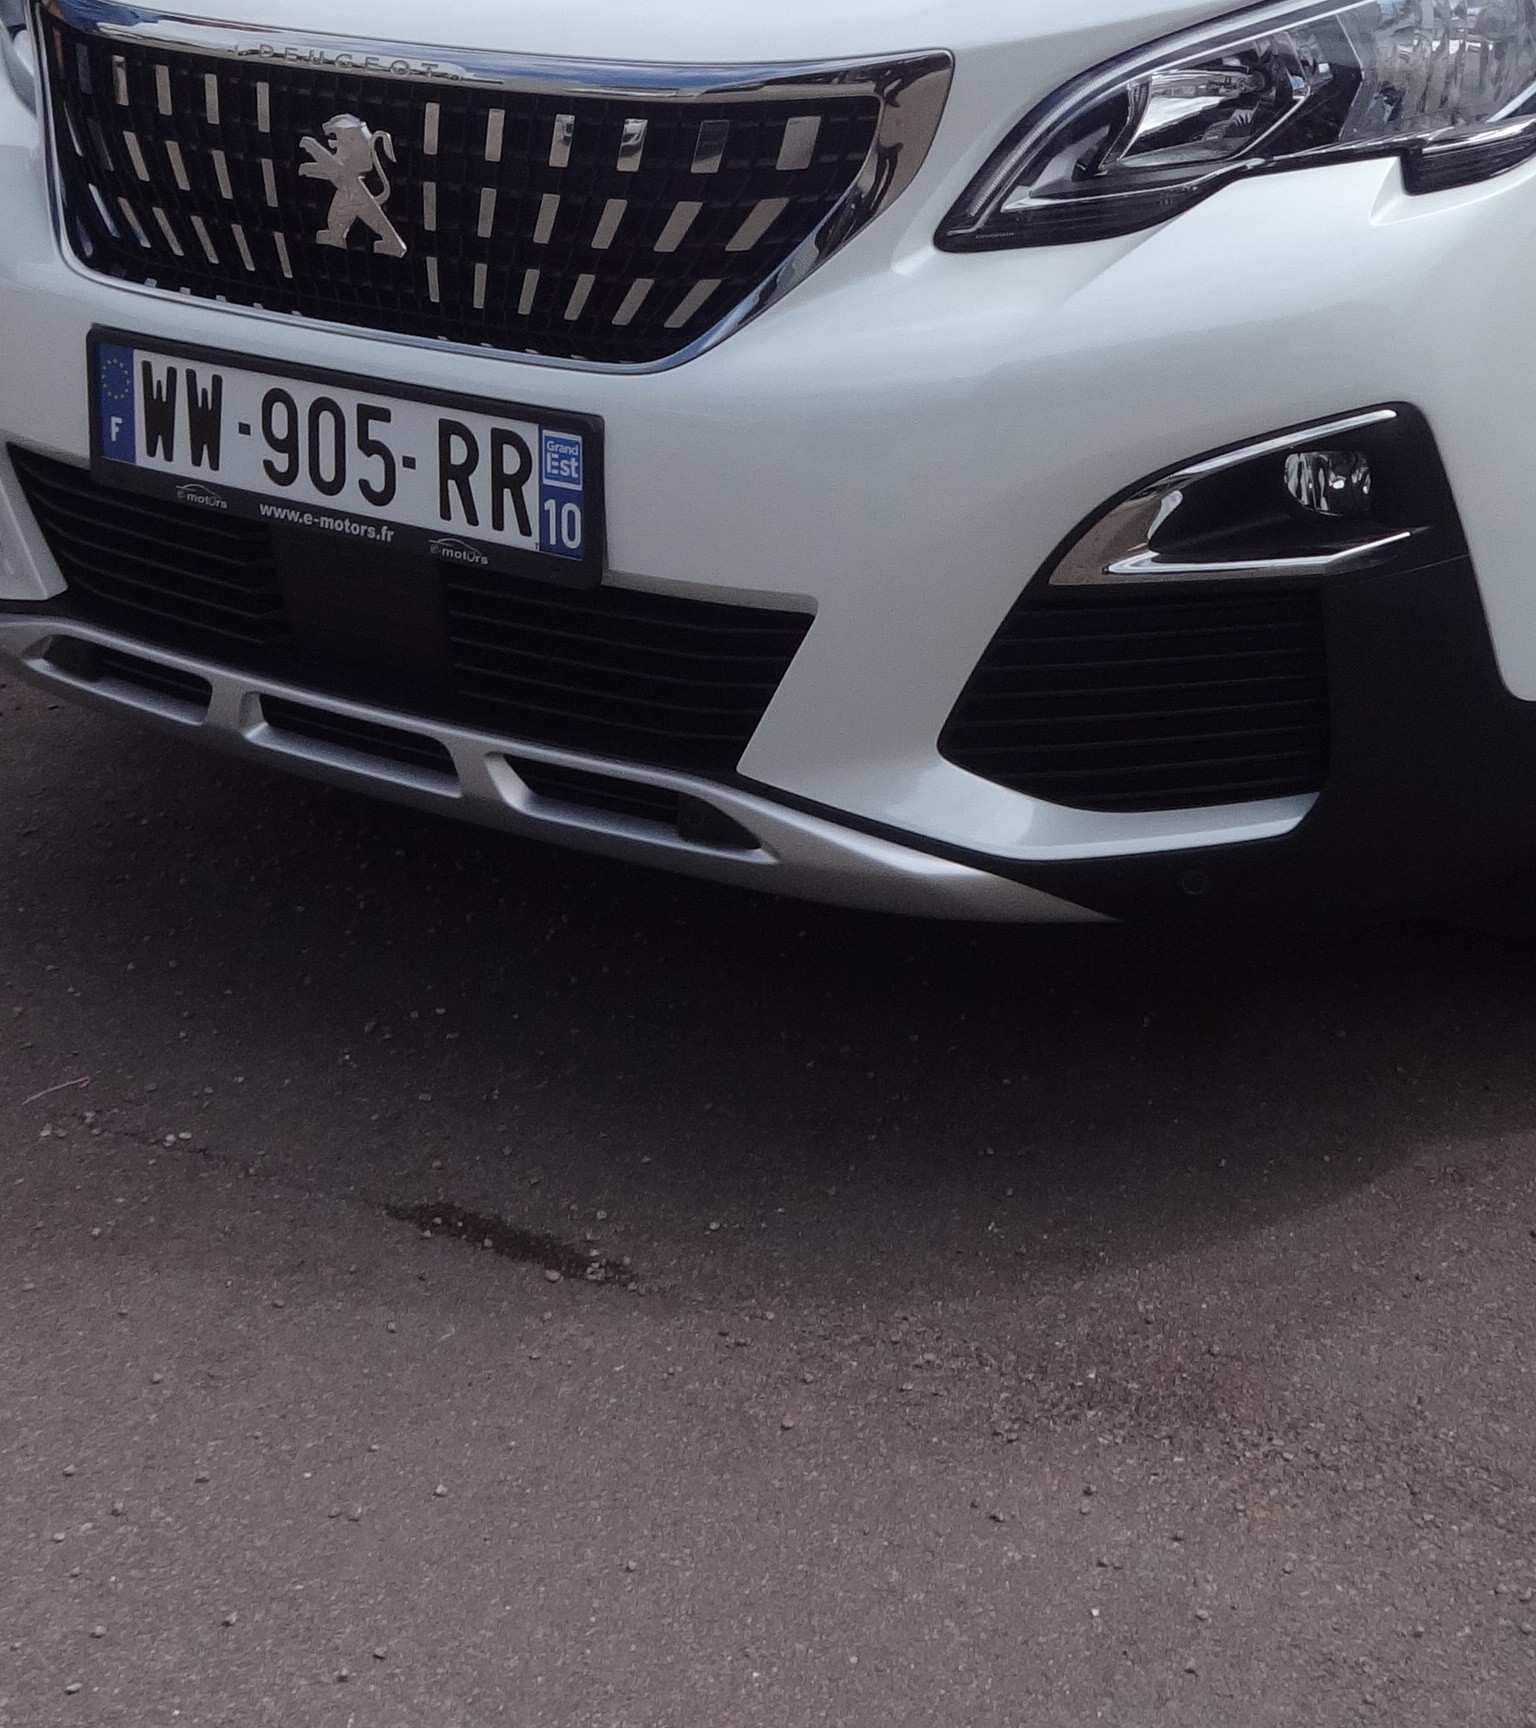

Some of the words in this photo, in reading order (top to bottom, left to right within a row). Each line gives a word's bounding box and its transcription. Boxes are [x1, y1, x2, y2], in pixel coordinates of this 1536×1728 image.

[111, 415, 123, 442] F
[141, 359, 533, 538] WW-905-RR
[546, 440, 579, 456] Grand
[546, 452, 579, 478] Est
[259, 503, 395, 542] www.e-motors.fr
[544, 498, 582, 549] 10
